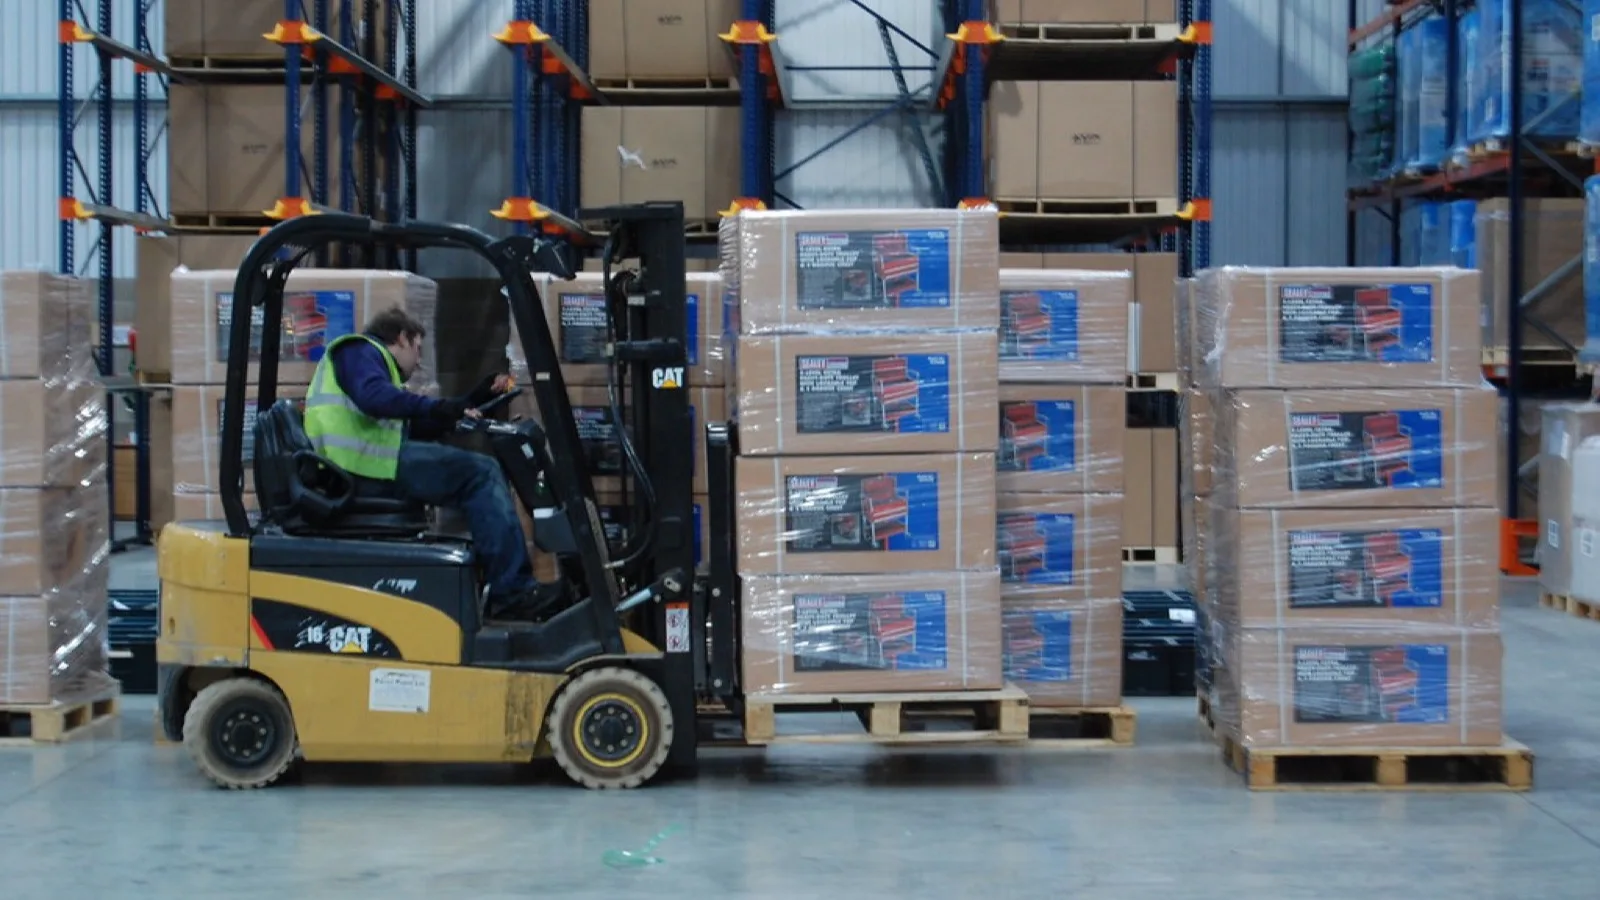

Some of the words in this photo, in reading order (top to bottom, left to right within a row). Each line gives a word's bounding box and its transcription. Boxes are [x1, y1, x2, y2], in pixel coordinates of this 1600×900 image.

[652, 367, 684, 389] CAT
[307, 625, 323, 643] 16
[329, 626, 371, 653] CAT
